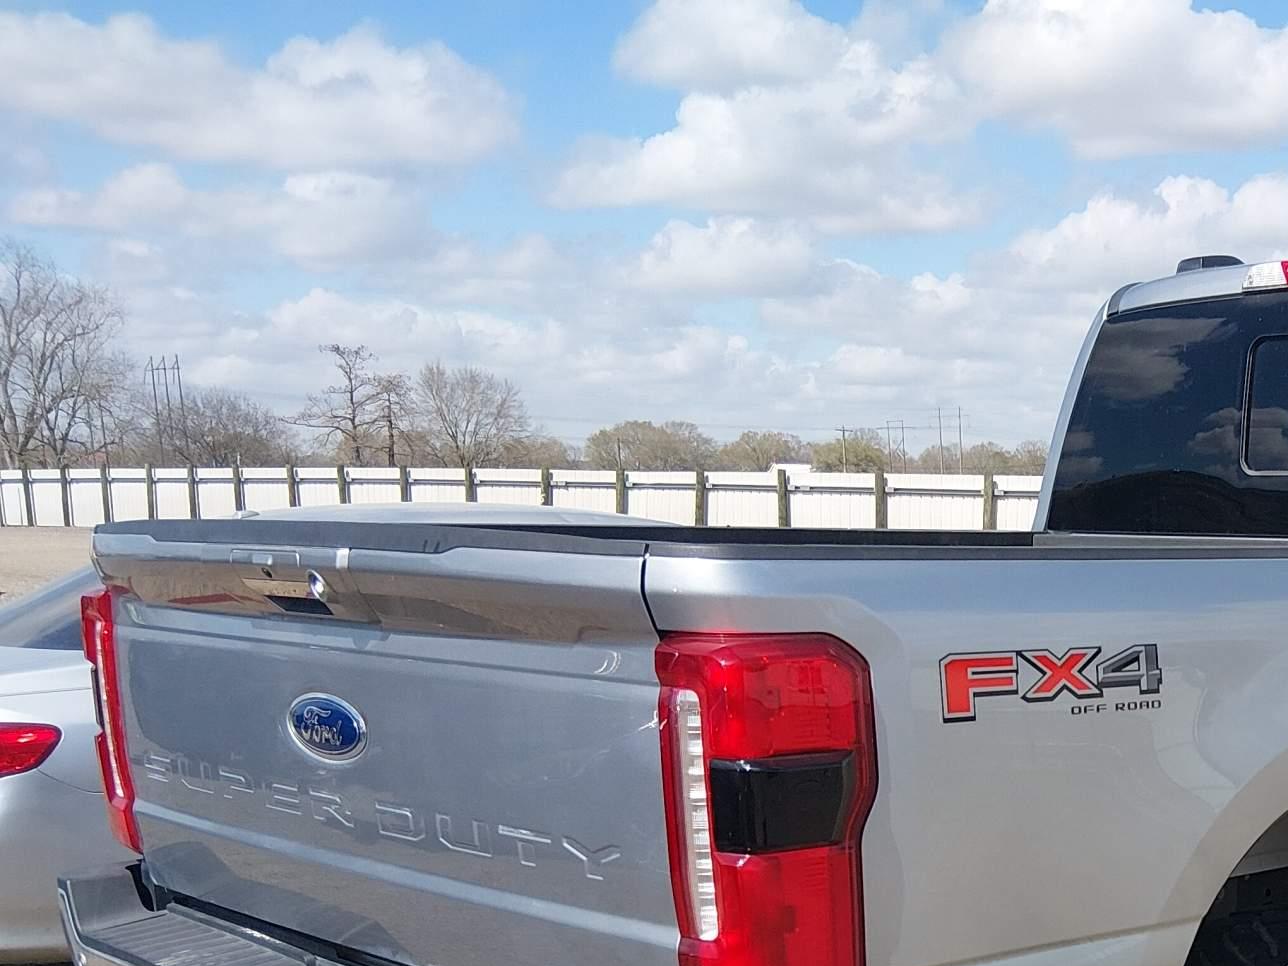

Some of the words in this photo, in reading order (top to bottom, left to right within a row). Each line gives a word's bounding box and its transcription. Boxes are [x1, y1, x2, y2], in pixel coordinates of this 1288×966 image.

[938, 643, 1163, 724] FX4
[1070, 703, 1108, 716] OFF
[1114, 699, 1162, 713] ROAD
[300, 705, 343, 746] Ford
[143, 753, 356, 828] SUPER
[374, 799, 621, 881] DUTY
